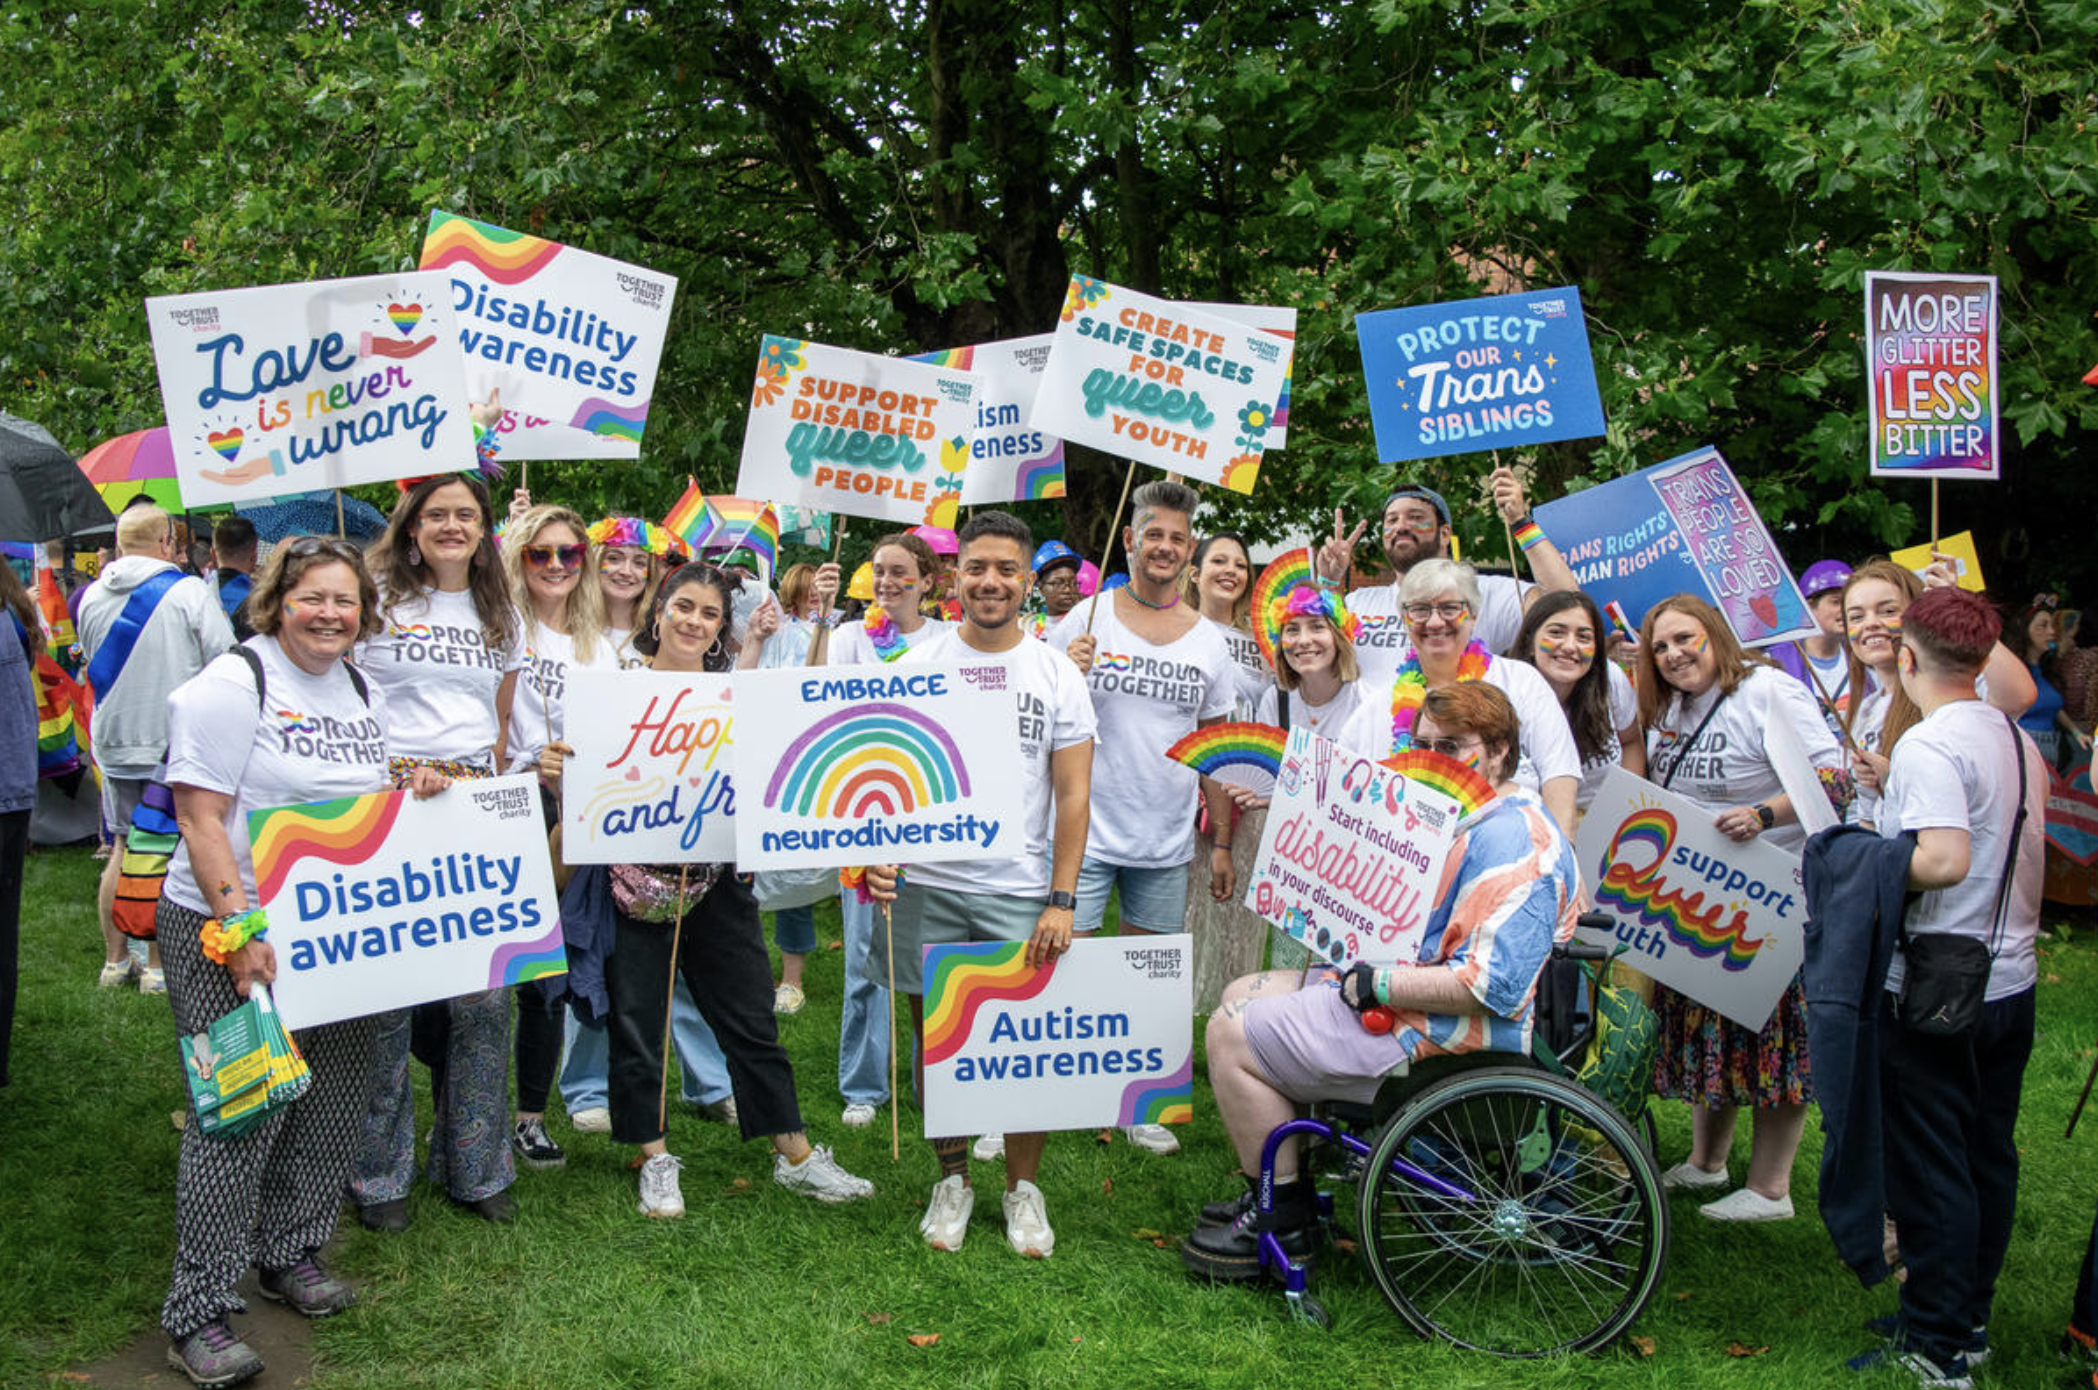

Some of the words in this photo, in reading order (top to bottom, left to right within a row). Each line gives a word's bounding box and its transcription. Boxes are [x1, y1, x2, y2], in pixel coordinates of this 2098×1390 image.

[616, 272, 665, 294] TOGETHER
[634, 287, 663, 302] TRUST
[169, 306, 219, 319] TOGETHER
[450, 278, 637, 362] Disability
[1119, 308, 1225, 354] CREATE
[1880, 293, 1982, 333] MORE
[1076, 316, 1146, 352] SAFE
[1149, 338, 1254, 384] SPACES
[1396, 316, 1546, 361] PROTECT
[1455, 346, 1501, 369] OUR
[1882, 336, 1982, 366] GLITTER
[196, 332, 355, 409] Love
[459, 328, 638, 396] wareness
[1128, 354, 1184, 386] FOR
[258, 398, 291, 432] is
[306, 366, 412, 419] never
[798, 376, 938, 419] SUPPORT
[1082, 368, 1215, 430] queer
[1408, 361, 1544, 413] Trans
[1883, 369, 1982, 421] LESS
[290, 394, 447, 465] wrong
[790, 399, 936, 441] DISABLED
[976, 400, 1019, 427] ism
[1418, 400, 1553, 444] SIBLINGS
[785, 421, 926, 477] queer
[972, 432, 1043, 459] eness
[1112, 414, 1208, 459] YOUTH
[1885, 424, 1984, 457] BITTER
[814, 466, 927, 502] PEOPLE
[1662, 468, 1731, 505] TRANS
[1679, 498, 1750, 535] PEOPLE
[1560, 538, 1602, 565] RANS
[1606, 511, 1667, 555] RIGHTS
[1571, 559, 1612, 584] MAN
[1618, 530, 1679, 576] RIGHTS
[1699, 536, 1737, 568] ARE
[1733, 528, 1766, 557] SO
[1709, 559, 1781, 599] LOVED
[431, 625, 489, 646] PRO
[391, 642, 506, 671] TOGETHE
[959, 666, 1006, 676] TOGETHER
[1131, 656, 1200, 682] PROUD
[801, 674, 948, 702] EMBRACE
[978, 675, 1006, 683] TRUST
[1093, 671, 1201, 704] TOGETHER
[472, 786, 530, 804] TOGETHER
[494, 797, 529, 811] TRUST
[499, 808, 532, 820] charity
[603, 785, 684, 836] and
[680, 770, 736, 850] fr
[762, 814, 1000, 851] neurodiversity
[1328, 803, 1364, 834] Start
[1364, 820, 1431, 874] including
[295, 852, 521, 922] Disability
[1268, 857, 1281, 879] in
[1280, 868, 1314, 897] your
[1312, 885, 1375, 936] discourse
[1274, 811, 1421, 943] disability
[1595, 808, 1765, 973] Queer
[1672, 846, 1795, 918] support
[290, 898, 541, 971] awareness
[1123, 949, 1181, 960] TOGETHER
[1147, 959, 1181, 970] TRUST
[1148, 970, 1181, 980] charity
[989, 1006, 1129, 1043] Autism
[955, 1047, 1164, 1082] awareness
